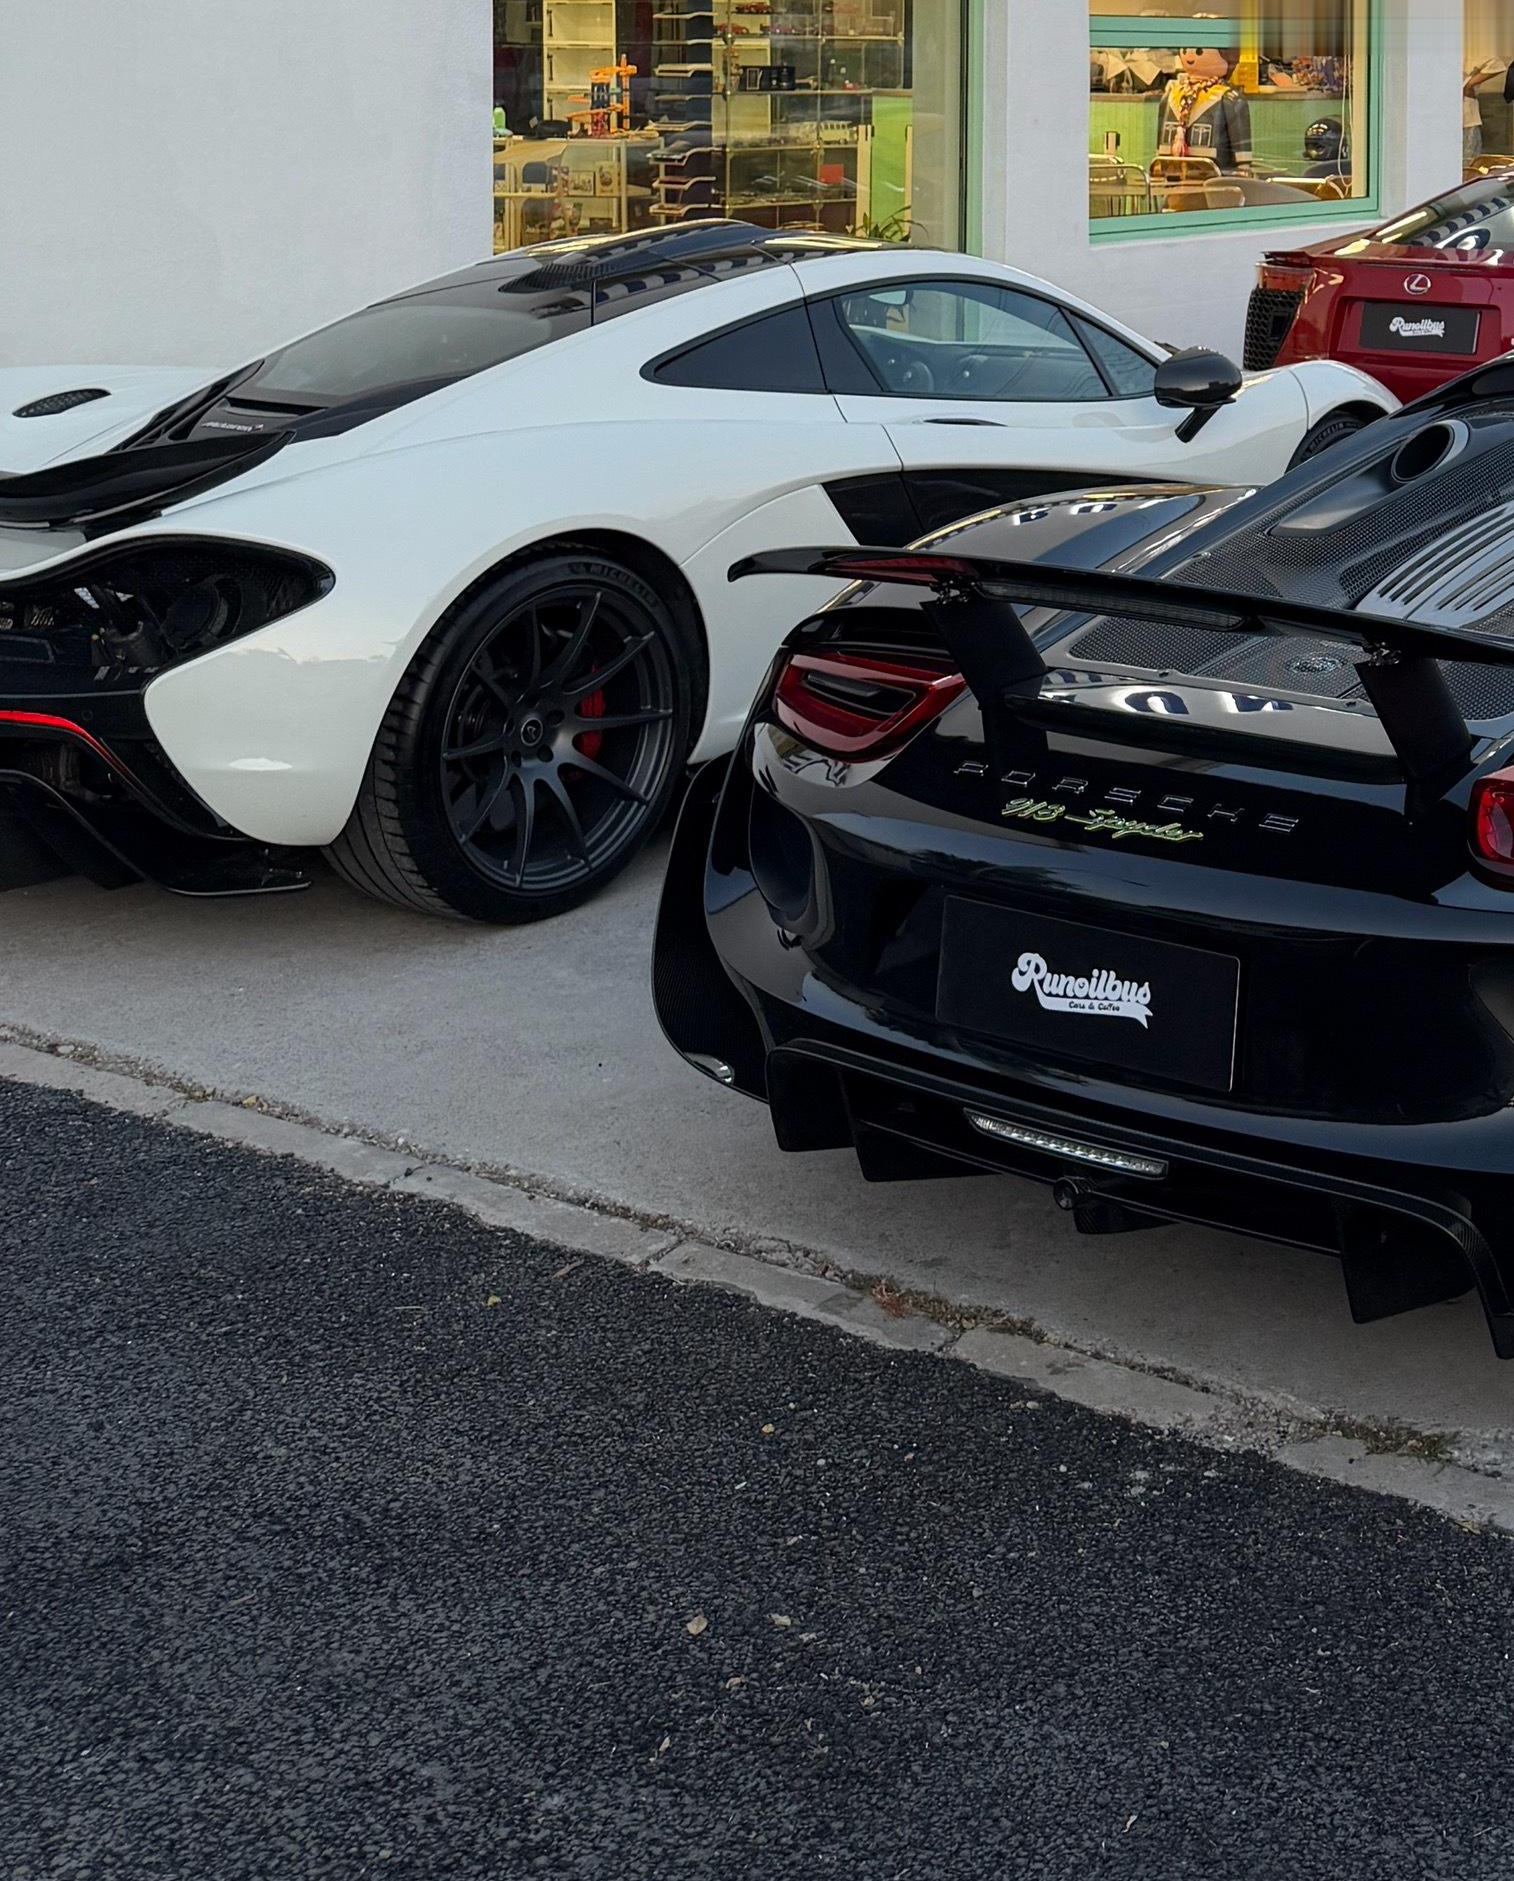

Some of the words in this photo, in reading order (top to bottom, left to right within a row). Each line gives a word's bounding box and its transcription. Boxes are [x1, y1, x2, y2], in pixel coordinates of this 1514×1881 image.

[1389, 316, 1445, 332] Runoilbus
[953, 760, 1300, 833] PORSCHE
[1001, 797, 1066, 821] 918
[1064, 808, 1204, 842] Spyder
[1011, 952, 1152, 1006] Runoilbus
